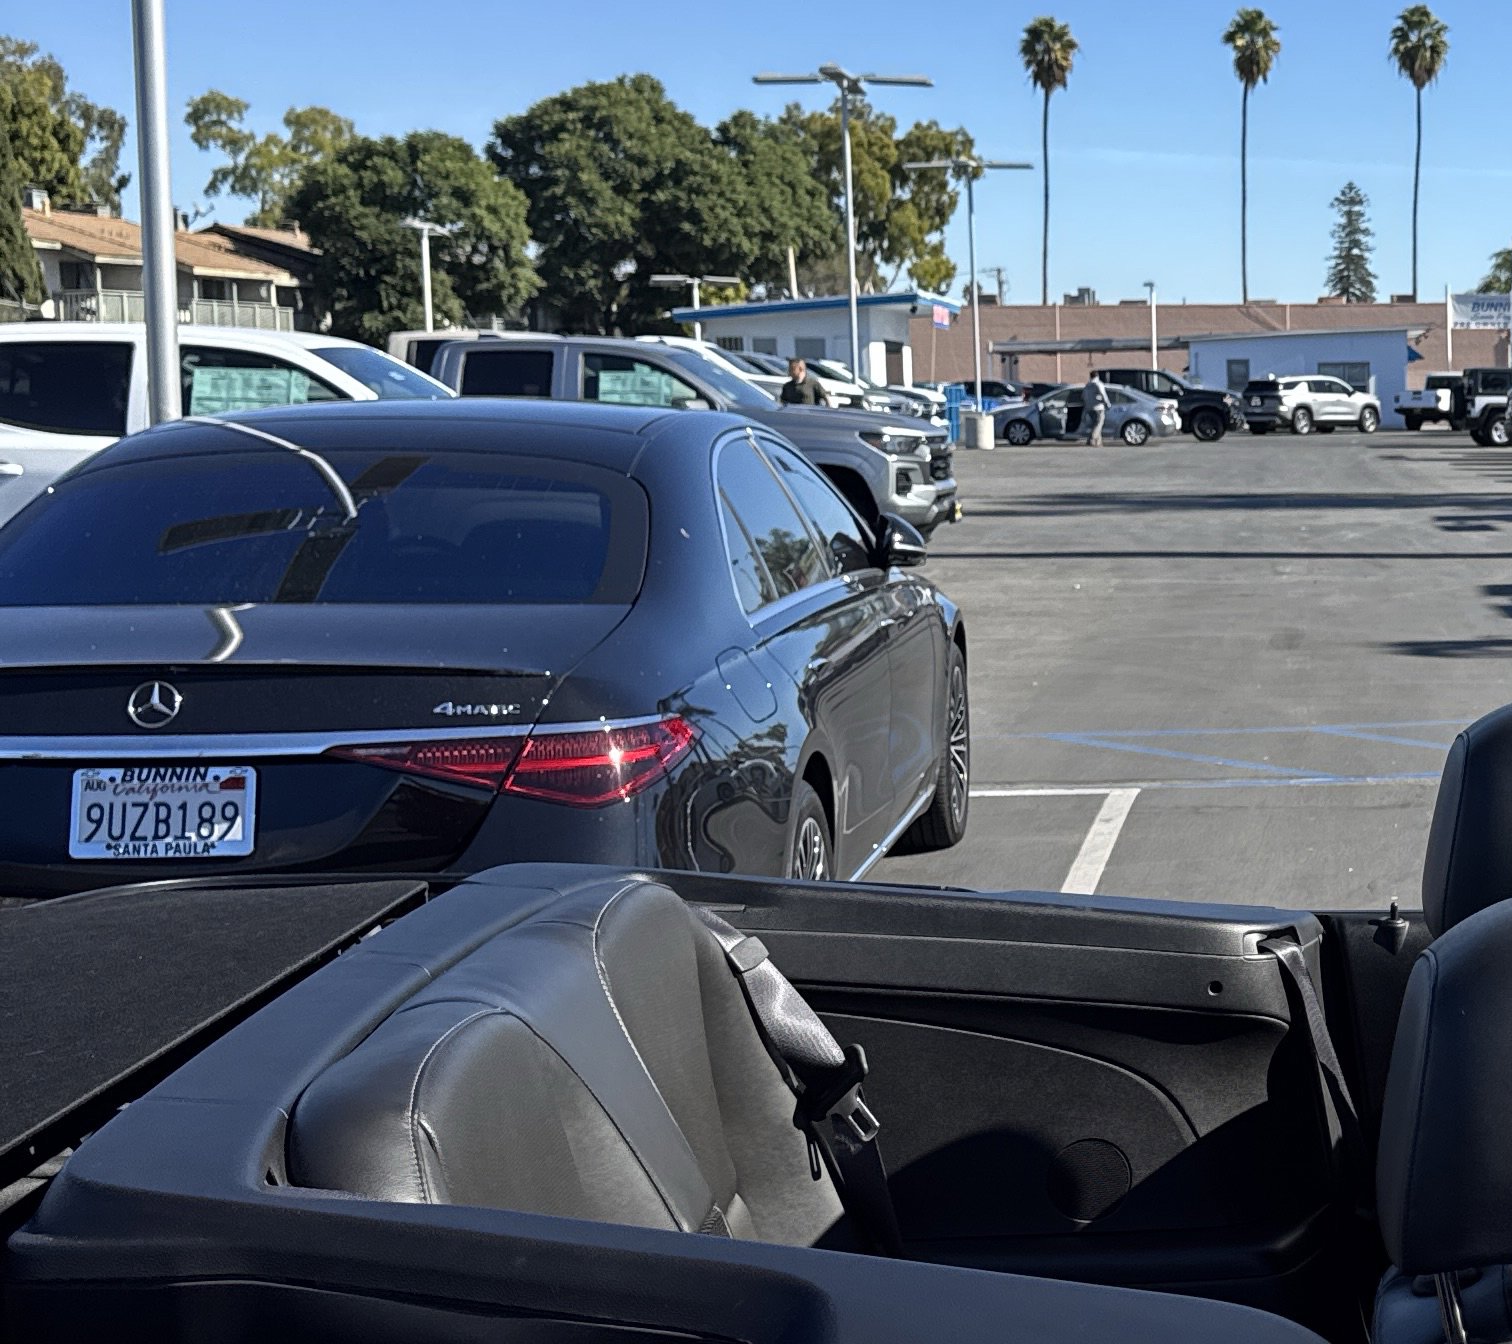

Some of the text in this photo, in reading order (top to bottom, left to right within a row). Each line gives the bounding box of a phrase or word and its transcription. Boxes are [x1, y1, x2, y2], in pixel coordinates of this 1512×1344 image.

[121, 767, 210, 784] BUNNIN
[113, 782, 210, 801] California
[84, 800, 240, 843] 9UZB189
